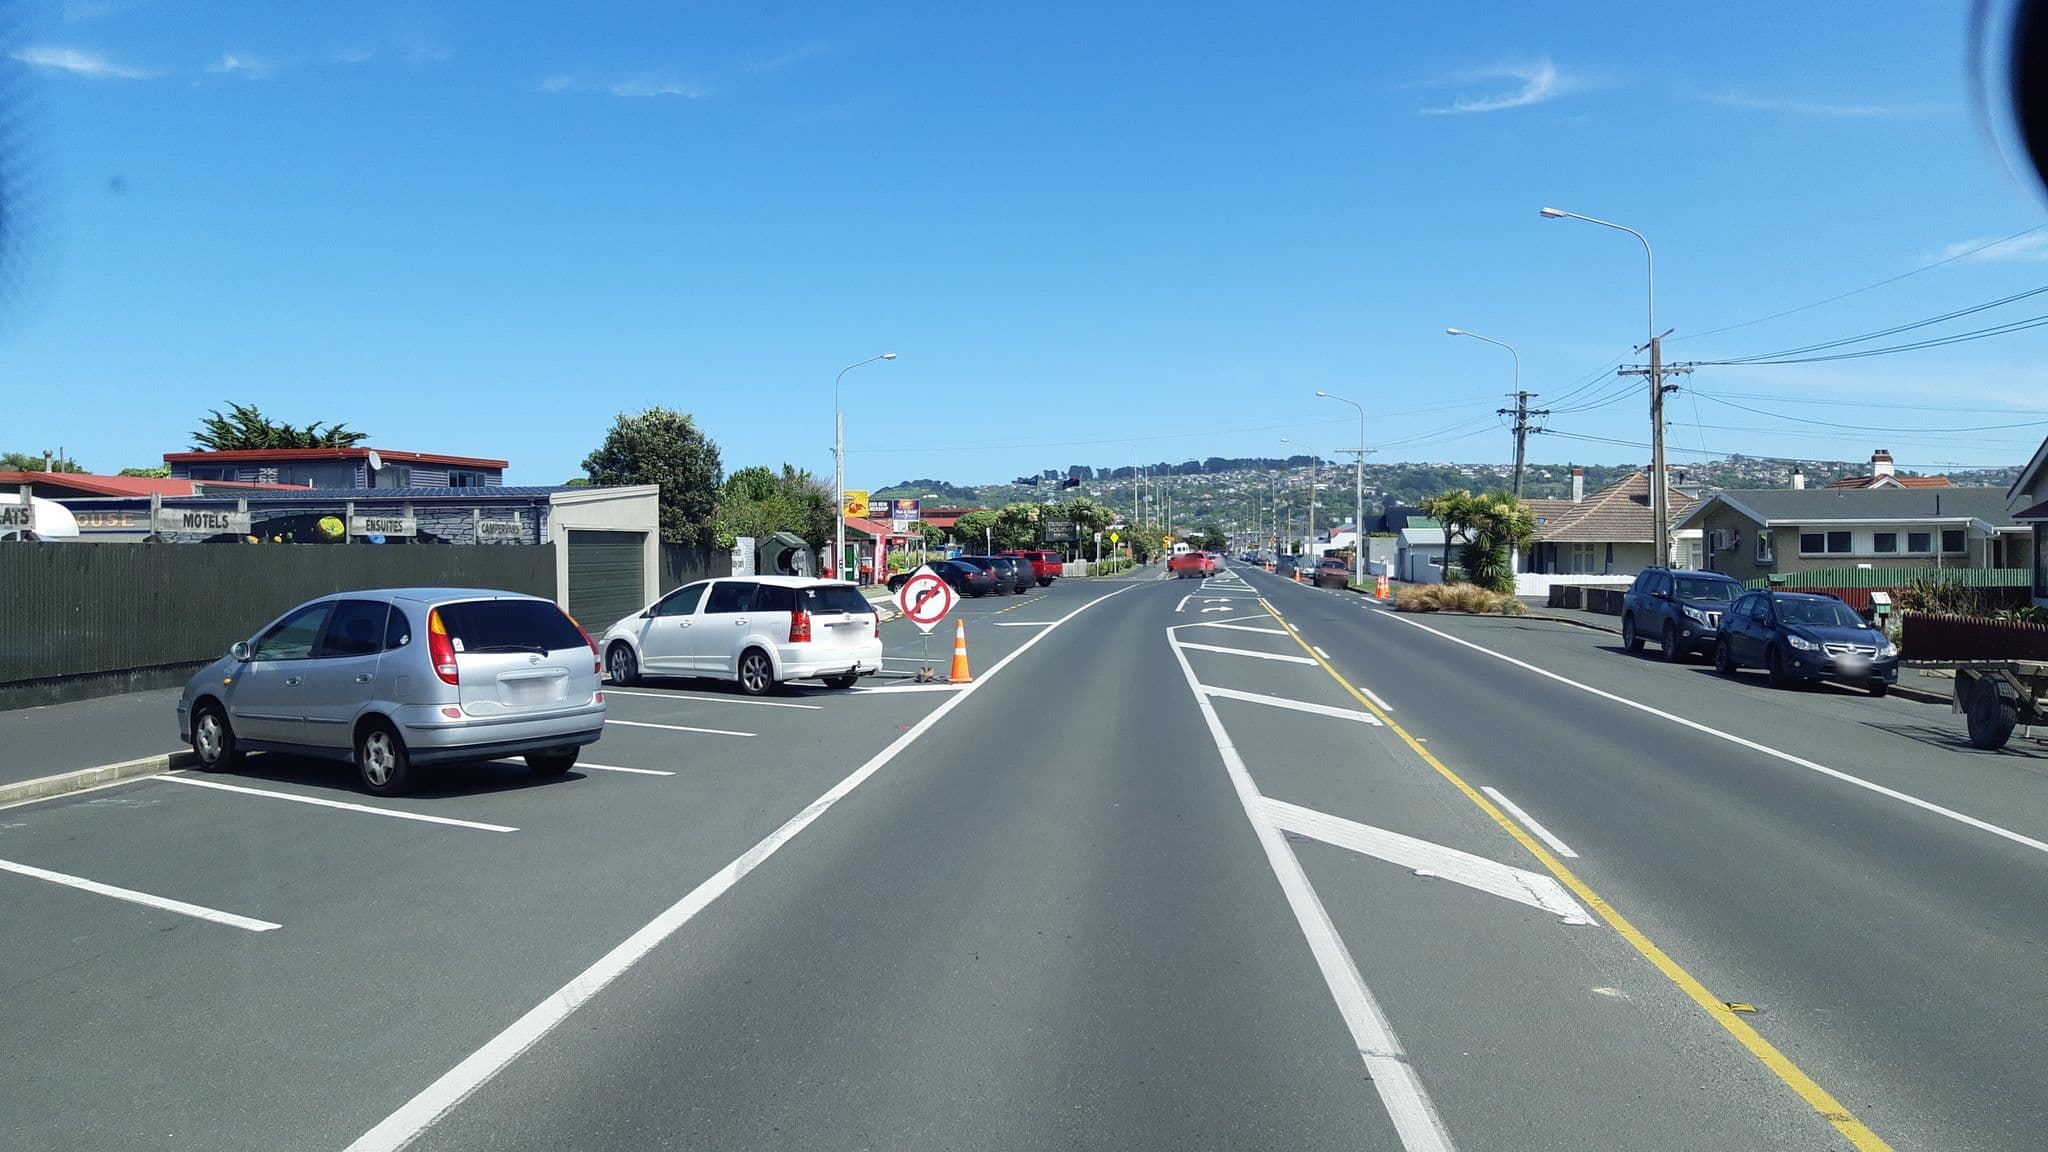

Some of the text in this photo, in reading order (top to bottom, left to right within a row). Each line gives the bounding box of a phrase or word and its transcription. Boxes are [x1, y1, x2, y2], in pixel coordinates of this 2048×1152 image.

[0, 507, 30, 525] ATS
[183, 513, 229, 529] MOTELS
[365, 519, 403, 533] ENSUITES
